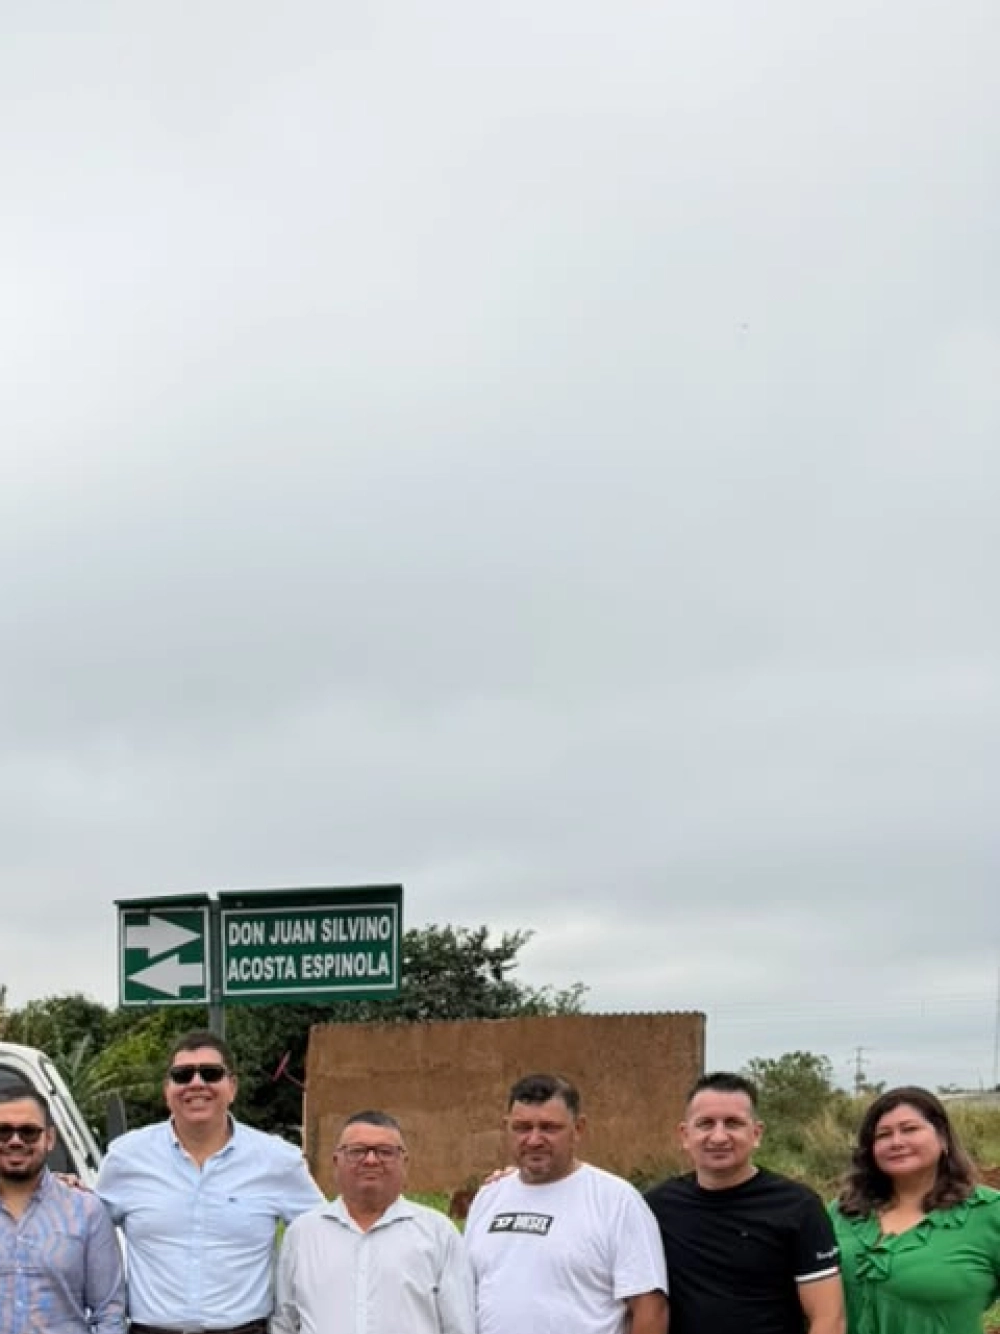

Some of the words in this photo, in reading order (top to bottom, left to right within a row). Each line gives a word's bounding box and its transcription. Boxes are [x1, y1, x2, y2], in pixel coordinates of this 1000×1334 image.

[228, 922, 264, 945] DON
[270, 919, 315, 944] JUAN
[321, 916, 391, 942] SILVINO
[228, 955, 296, 980] ACOSTA
[302, 952, 389, 979] ESPINOLA
